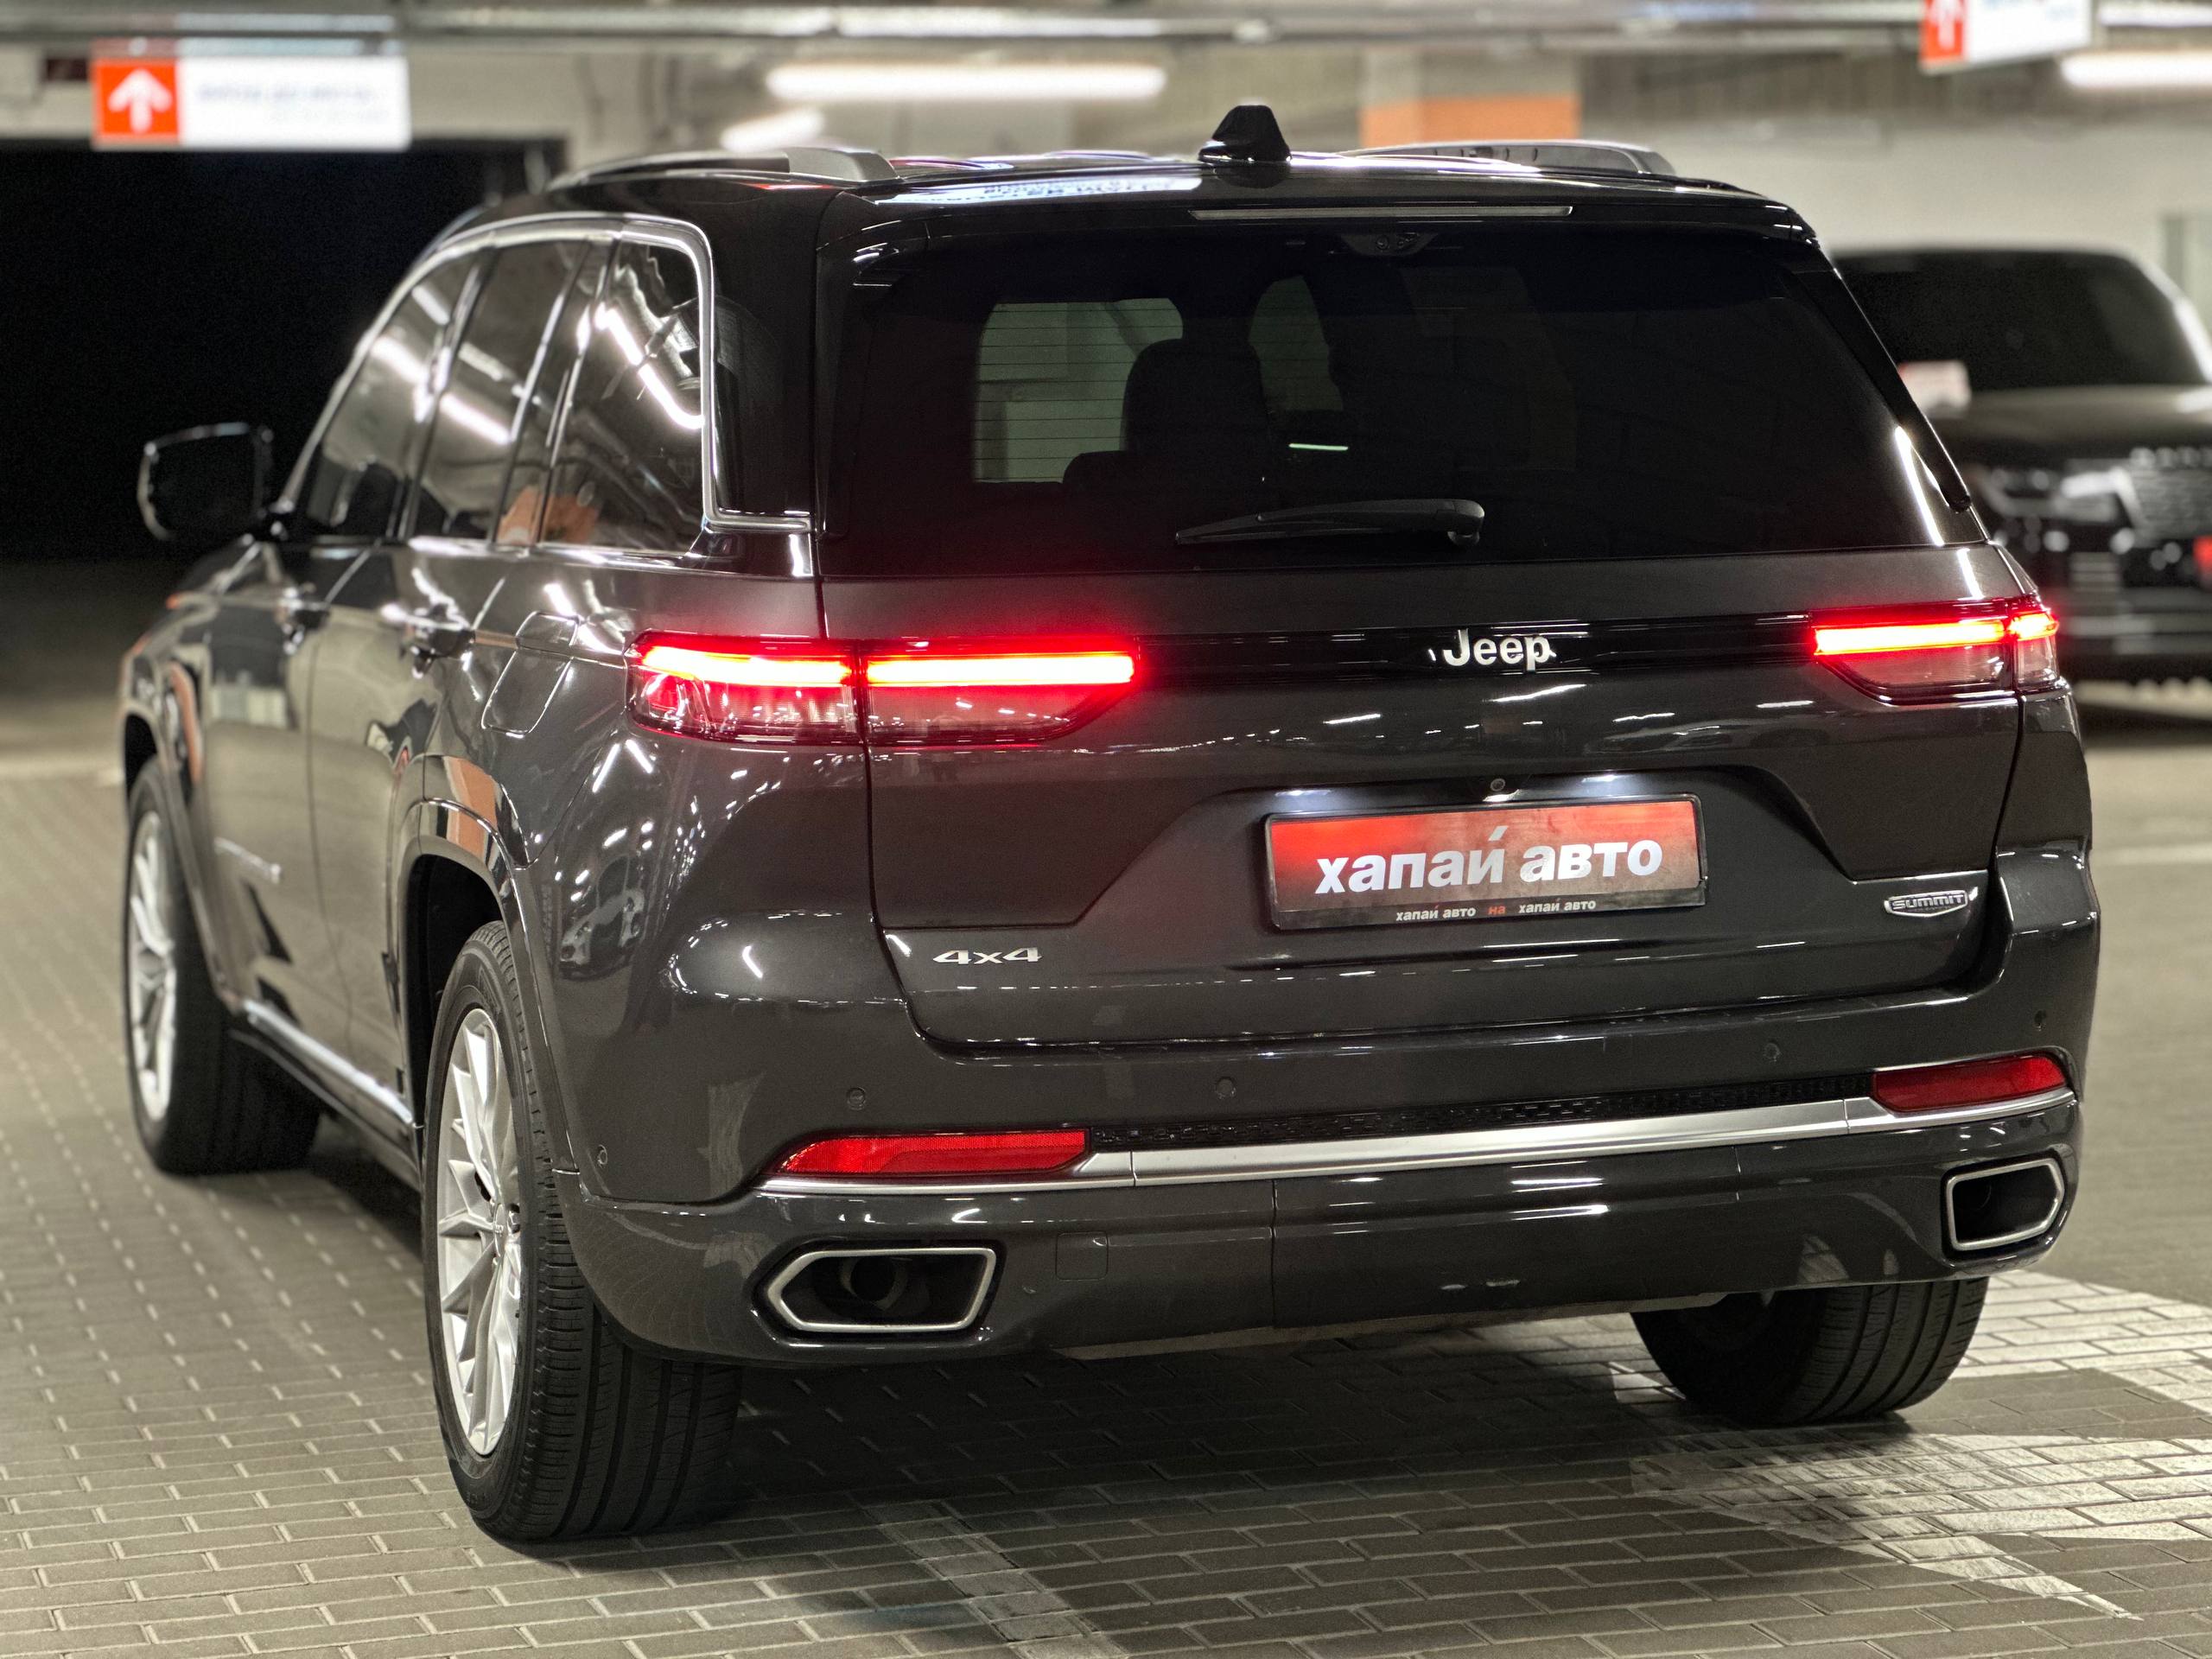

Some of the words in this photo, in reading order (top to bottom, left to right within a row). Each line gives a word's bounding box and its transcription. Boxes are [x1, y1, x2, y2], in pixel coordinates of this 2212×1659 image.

[1443, 628, 1552, 671] Jeep
[1519, 839, 1662, 882] авто
[1442, 907, 1477, 918] авто
[1487, 905, 1506, 916] на
[1563, 900, 1597, 912] авто
[932, 947, 1042, 965] 4x4
